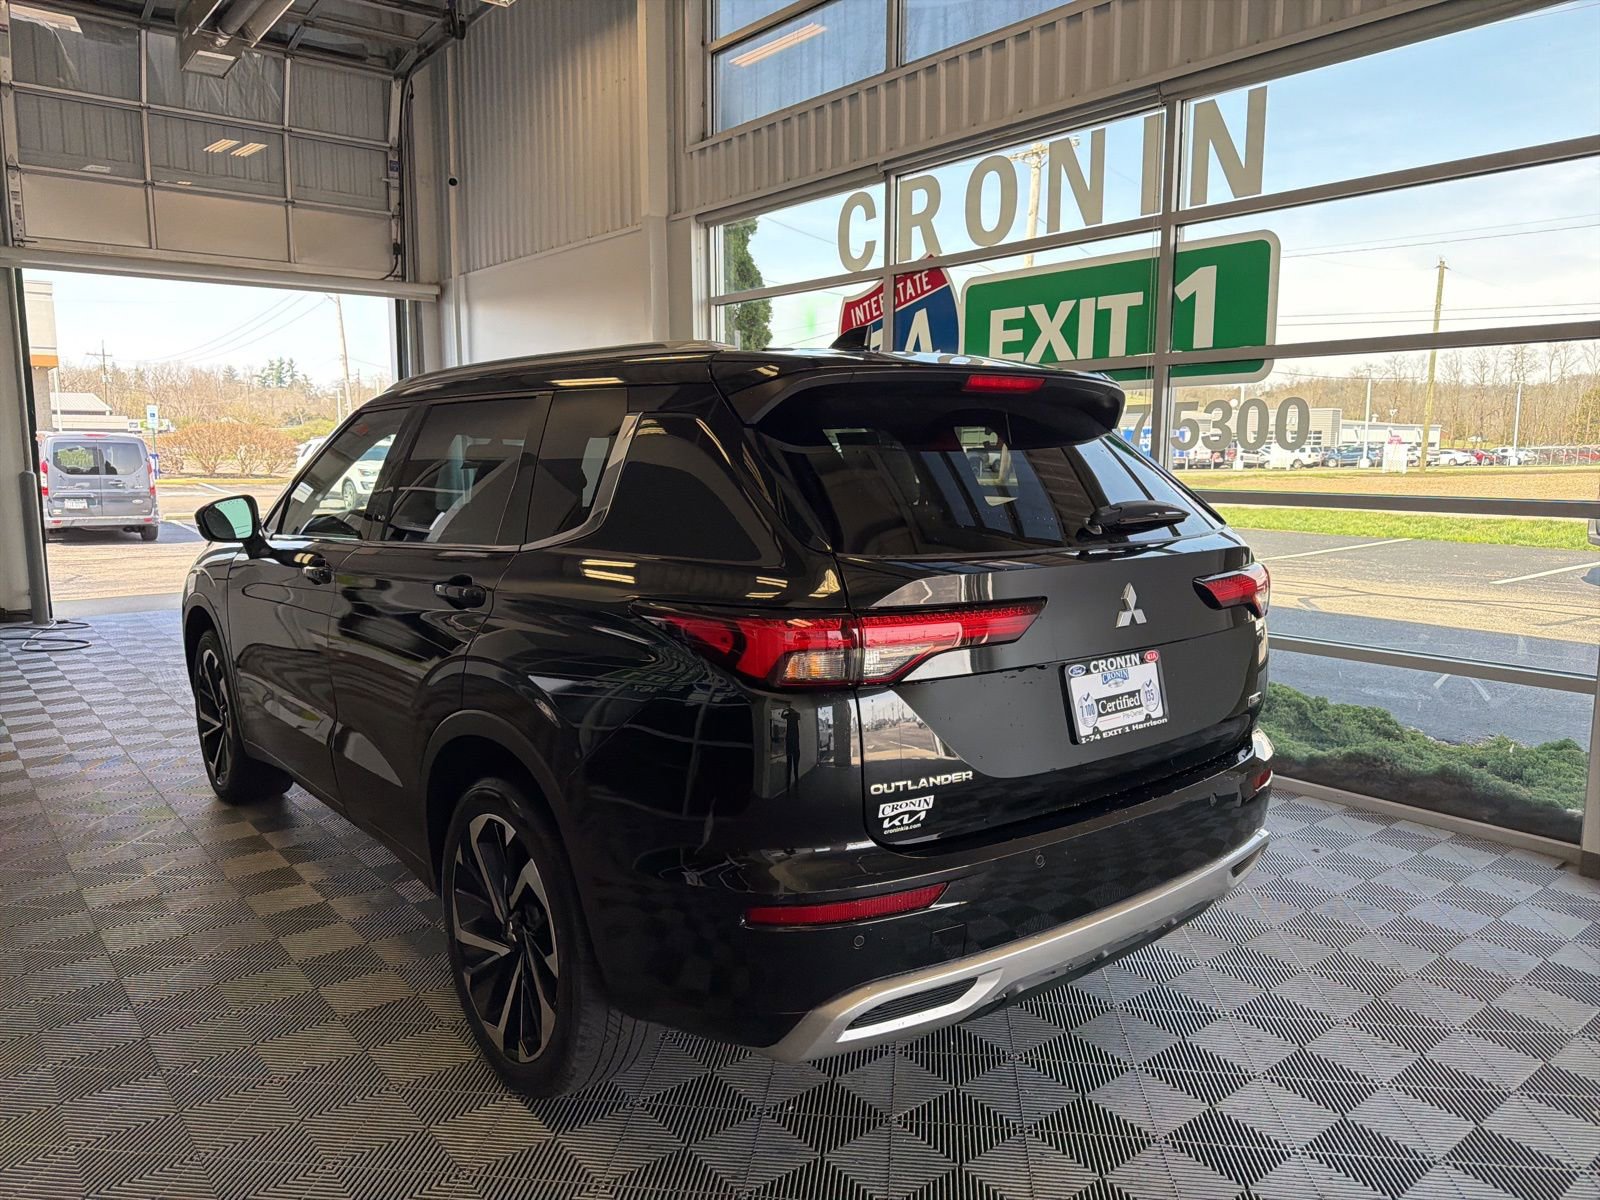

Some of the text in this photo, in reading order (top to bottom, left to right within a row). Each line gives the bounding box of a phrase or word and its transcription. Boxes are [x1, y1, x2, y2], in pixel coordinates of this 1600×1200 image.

[838, 86, 1268, 272] CRONIN
[851, 270, 932, 328] INTERTATE
[989, 265, 1218, 363] EXIT 1
[1090, 653, 1141, 673] CRONIN
[1102, 669, 1128, 683] CRONIN
[1099, 692, 1141, 714] Certified
[1081, 718, 1168, 744] I-74 EXIT 1 Harrison
[870, 770, 973, 795] OUTLANDER
[881, 796, 933, 816] CRONIN
[884, 823, 922, 835] croninkia.com
